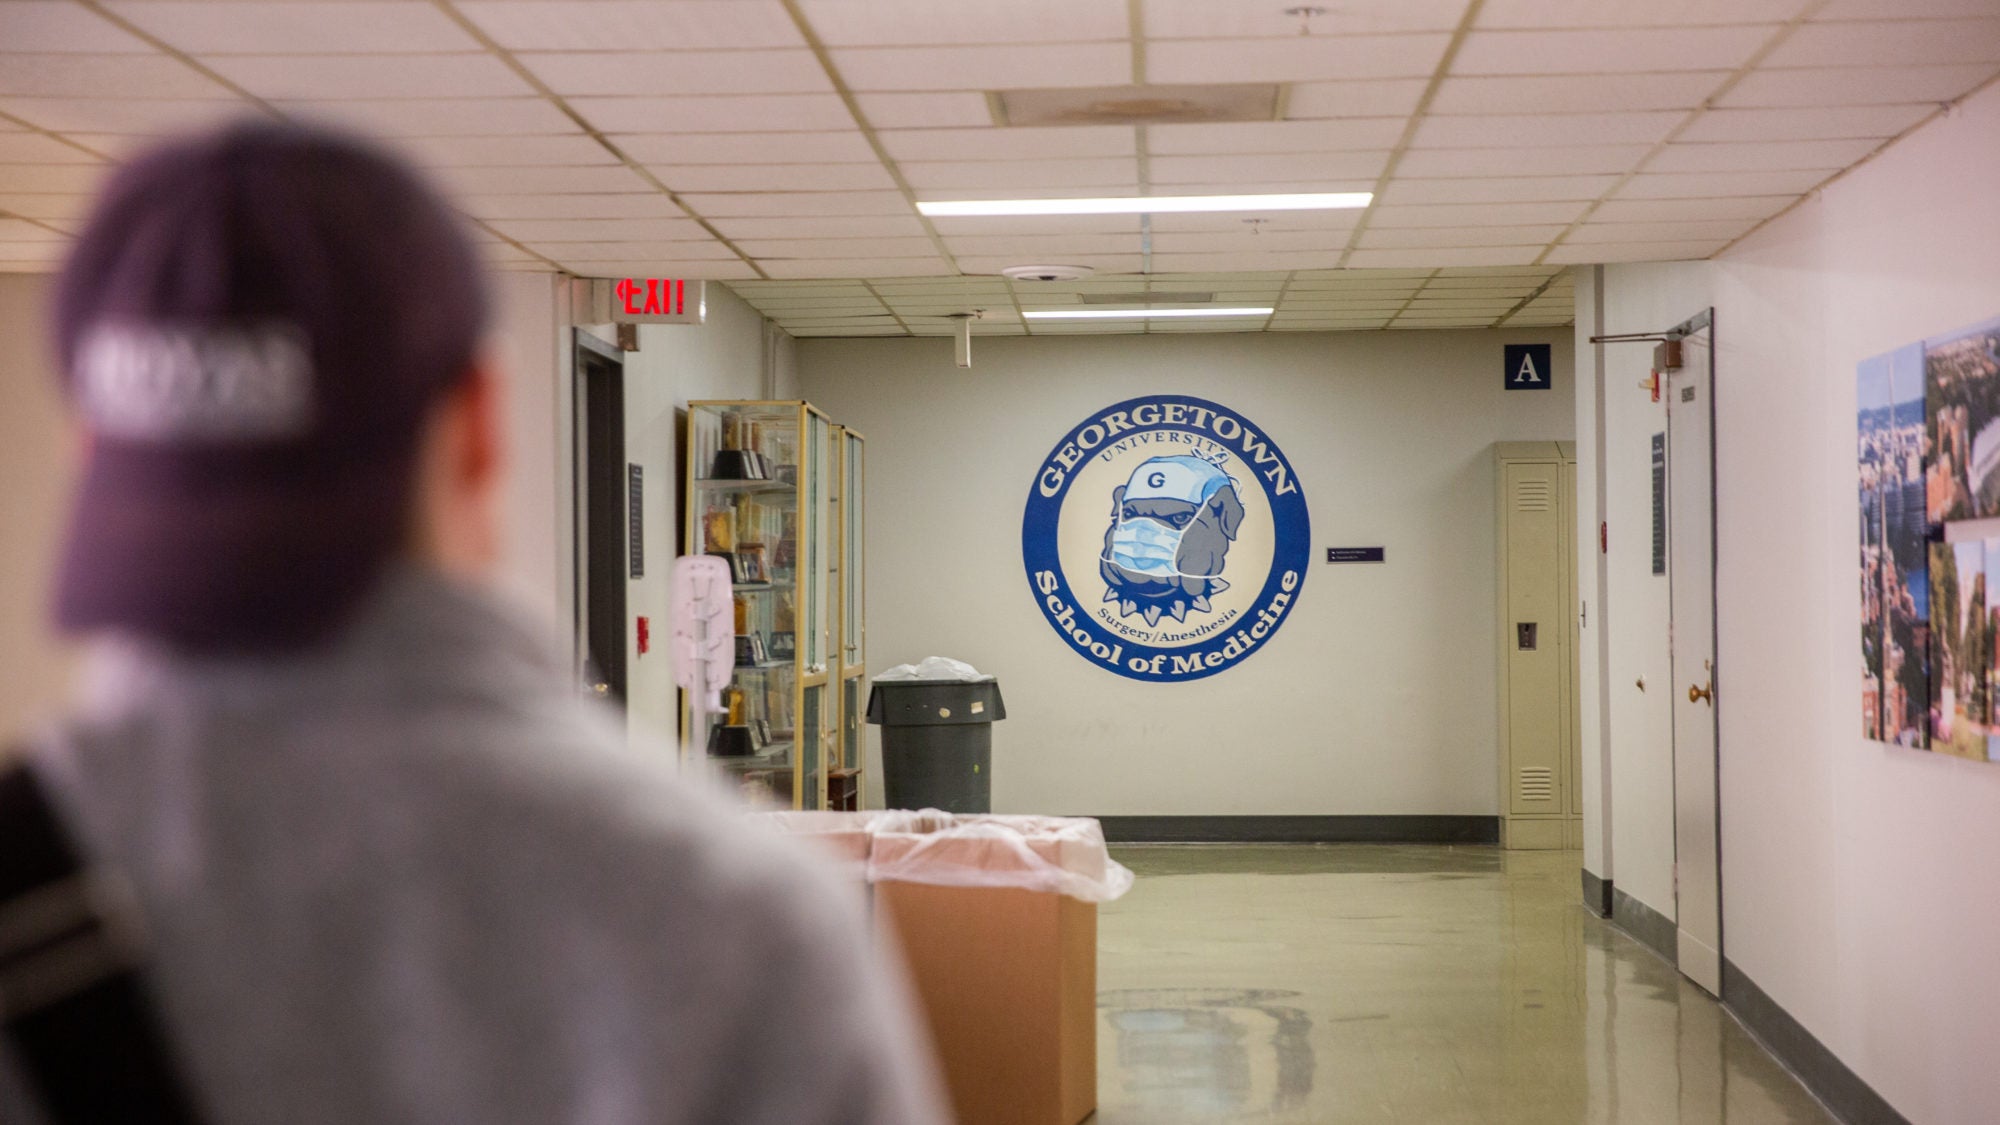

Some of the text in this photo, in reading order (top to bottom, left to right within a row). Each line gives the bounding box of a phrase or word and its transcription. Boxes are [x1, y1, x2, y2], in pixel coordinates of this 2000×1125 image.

[1514, 352, 1541, 382] A
[1039, 403, 1297, 498] GEORGETOWN
[1147, 472, 1165, 488] G
[1035, 570, 1298, 674] School of Medicine
[1098, 607, 1237, 642] Surgery/Anesthesia
